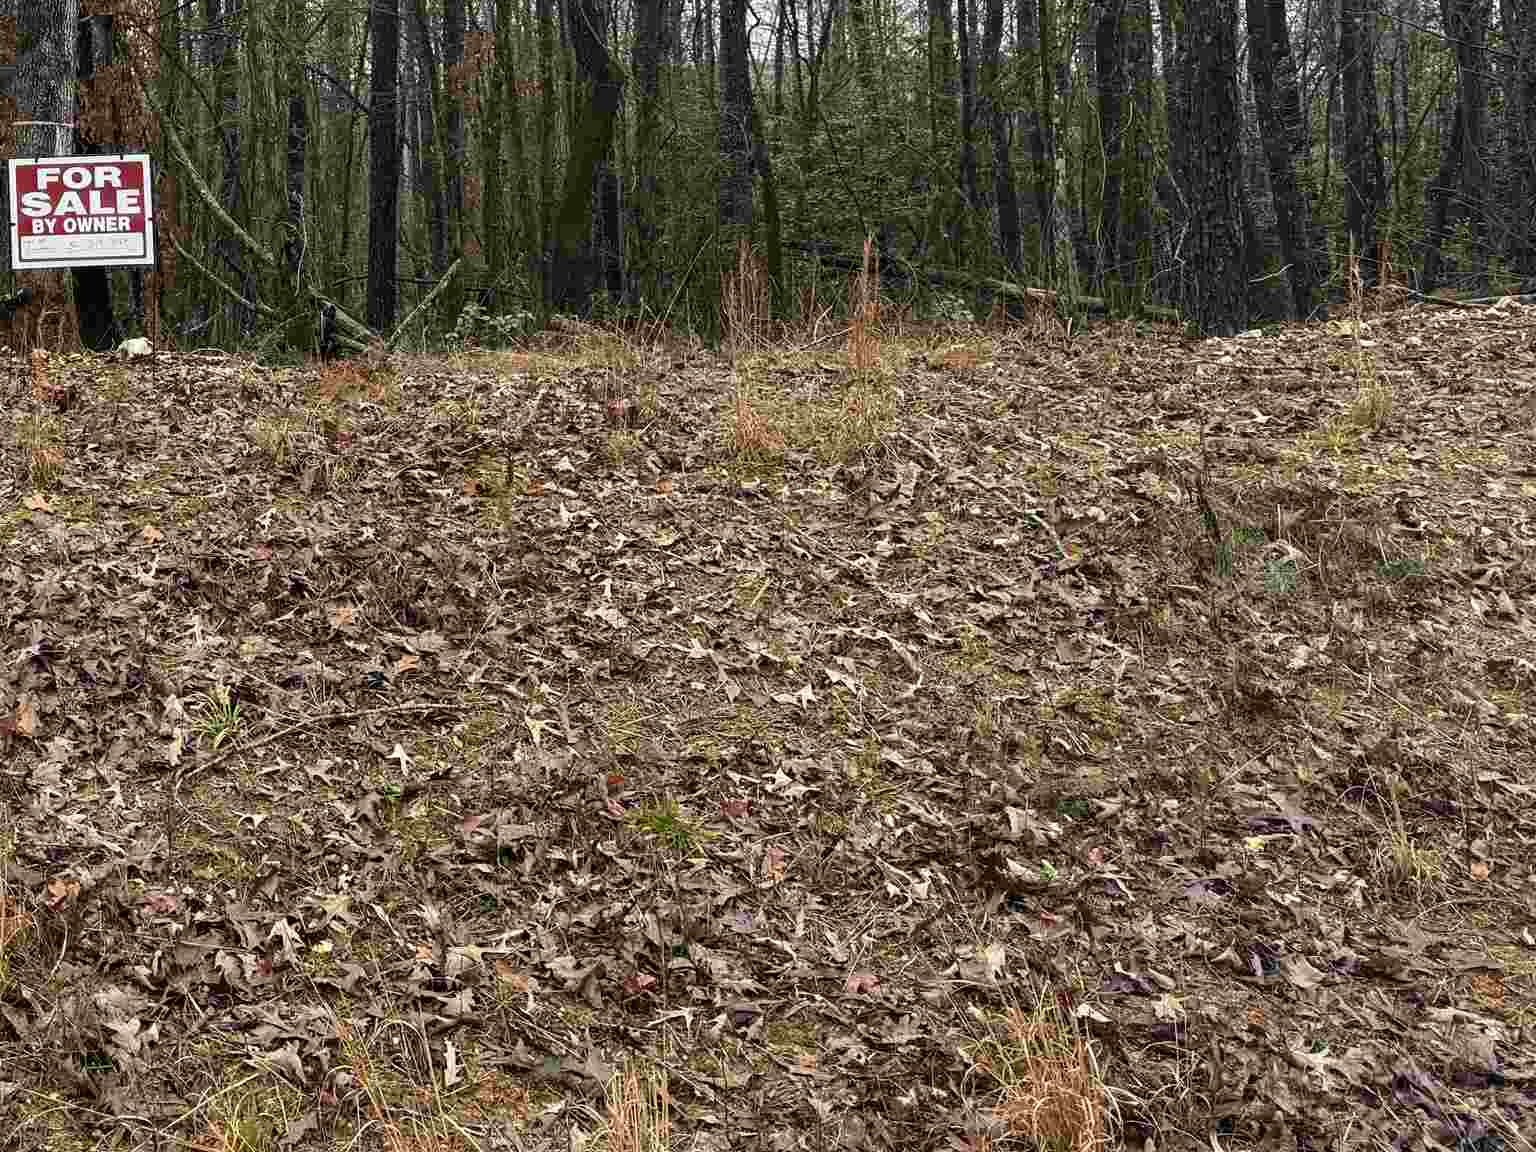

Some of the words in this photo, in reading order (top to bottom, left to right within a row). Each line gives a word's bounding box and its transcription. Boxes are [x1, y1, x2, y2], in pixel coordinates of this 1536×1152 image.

[37, 166, 122, 190] FOR
[21, 189, 141, 217] SALE
[32, 218, 56, 234] BY
[64, 216, 131, 233] OWNER
